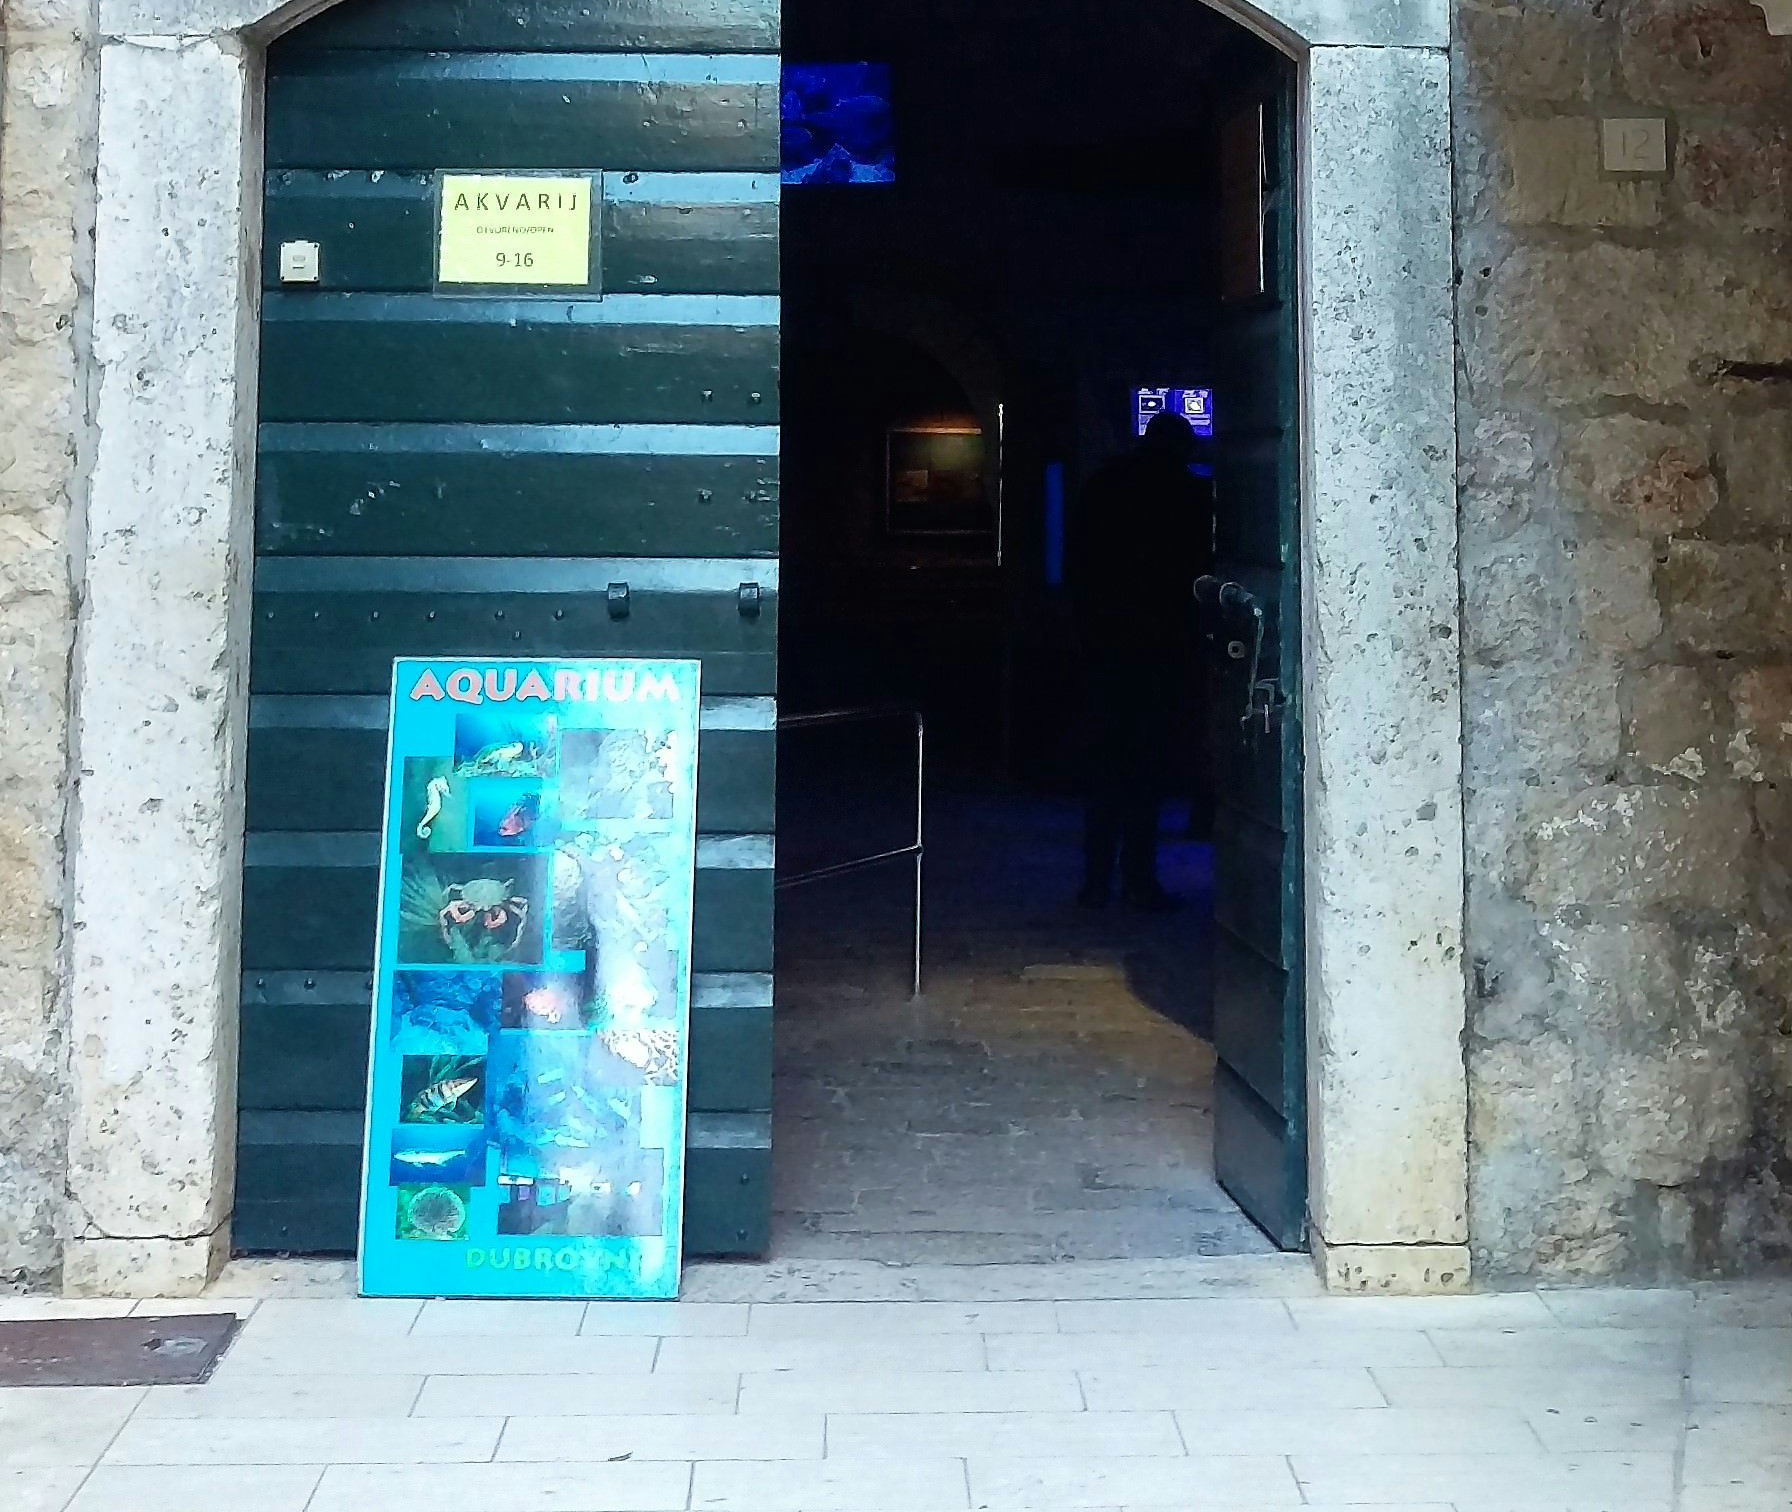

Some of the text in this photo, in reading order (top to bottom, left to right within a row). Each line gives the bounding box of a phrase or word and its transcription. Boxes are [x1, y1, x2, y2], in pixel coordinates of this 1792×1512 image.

[1621, 128, 1650, 160] 12
[454, 192, 577, 211] AKVARIJ
[409, 667, 681, 705] AQUARIUM
